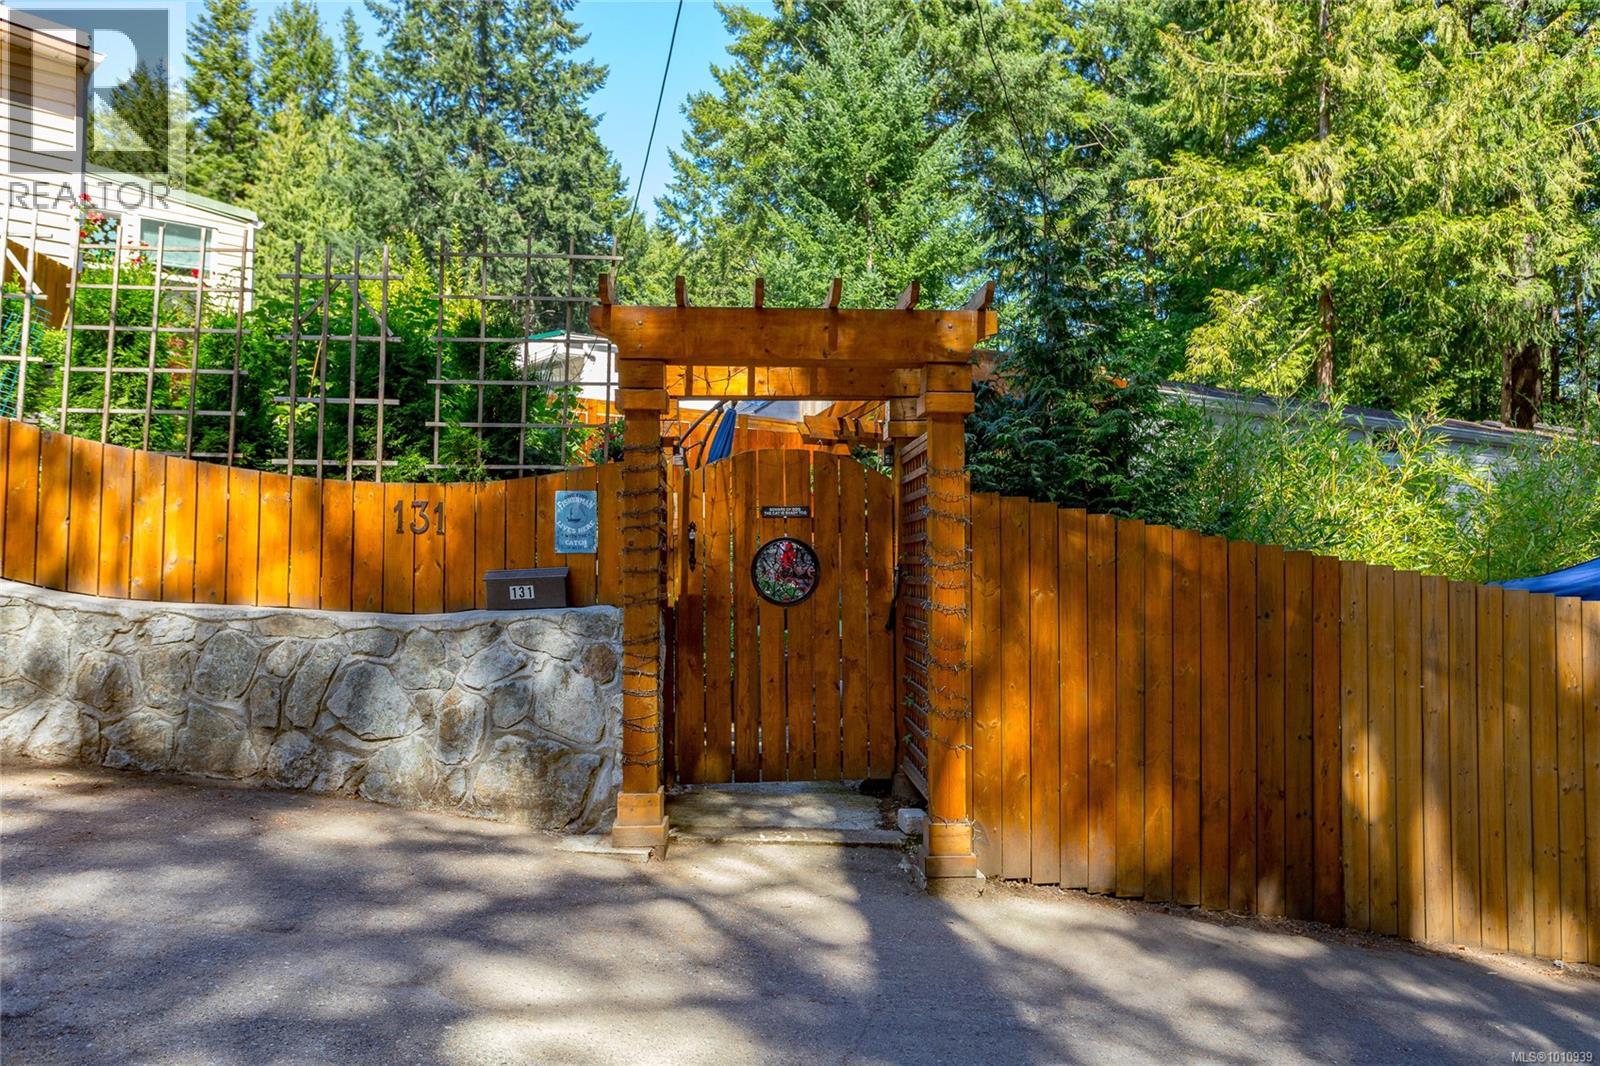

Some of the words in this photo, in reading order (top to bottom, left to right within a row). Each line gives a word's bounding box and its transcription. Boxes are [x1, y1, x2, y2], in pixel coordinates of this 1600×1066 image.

[556, 496, 596, 512] FISHERMAN
[393, 499, 446, 535] 131
[556, 520, 577, 534] LIVES
[577, 520, 595, 534] HERE
[564, 539, 588, 548] CATCH
[512, 586, 532, 598] 131
